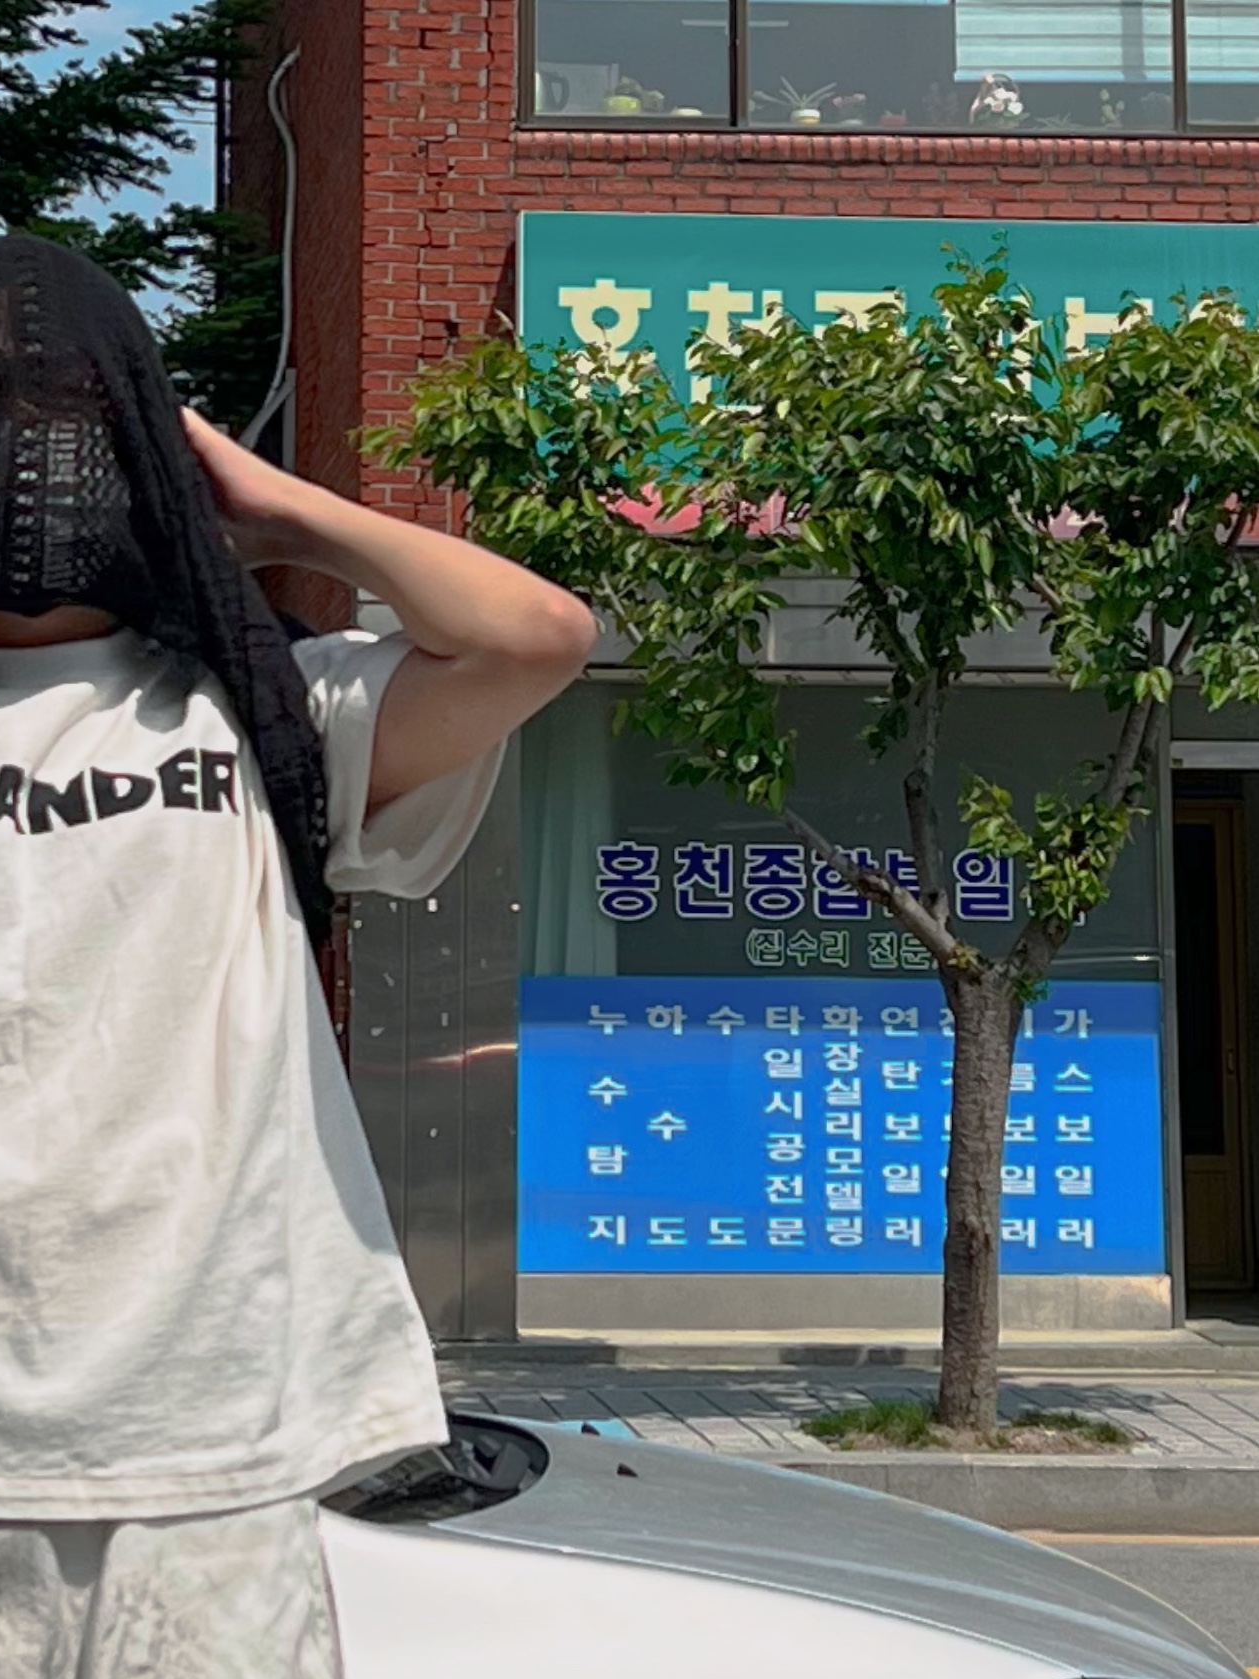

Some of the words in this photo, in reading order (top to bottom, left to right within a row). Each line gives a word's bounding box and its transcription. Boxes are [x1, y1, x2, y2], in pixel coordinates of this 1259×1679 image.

[587, 1004, 628, 1246] 누수탐지
[763, 1004, 806, 1247] 타일시공전문
[821, 1004, 864, 1247] 화장실리모델링
[880, 1006, 924, 1248] 연탄보일러
[1053, 1008, 1095, 1250] 가스보일러
